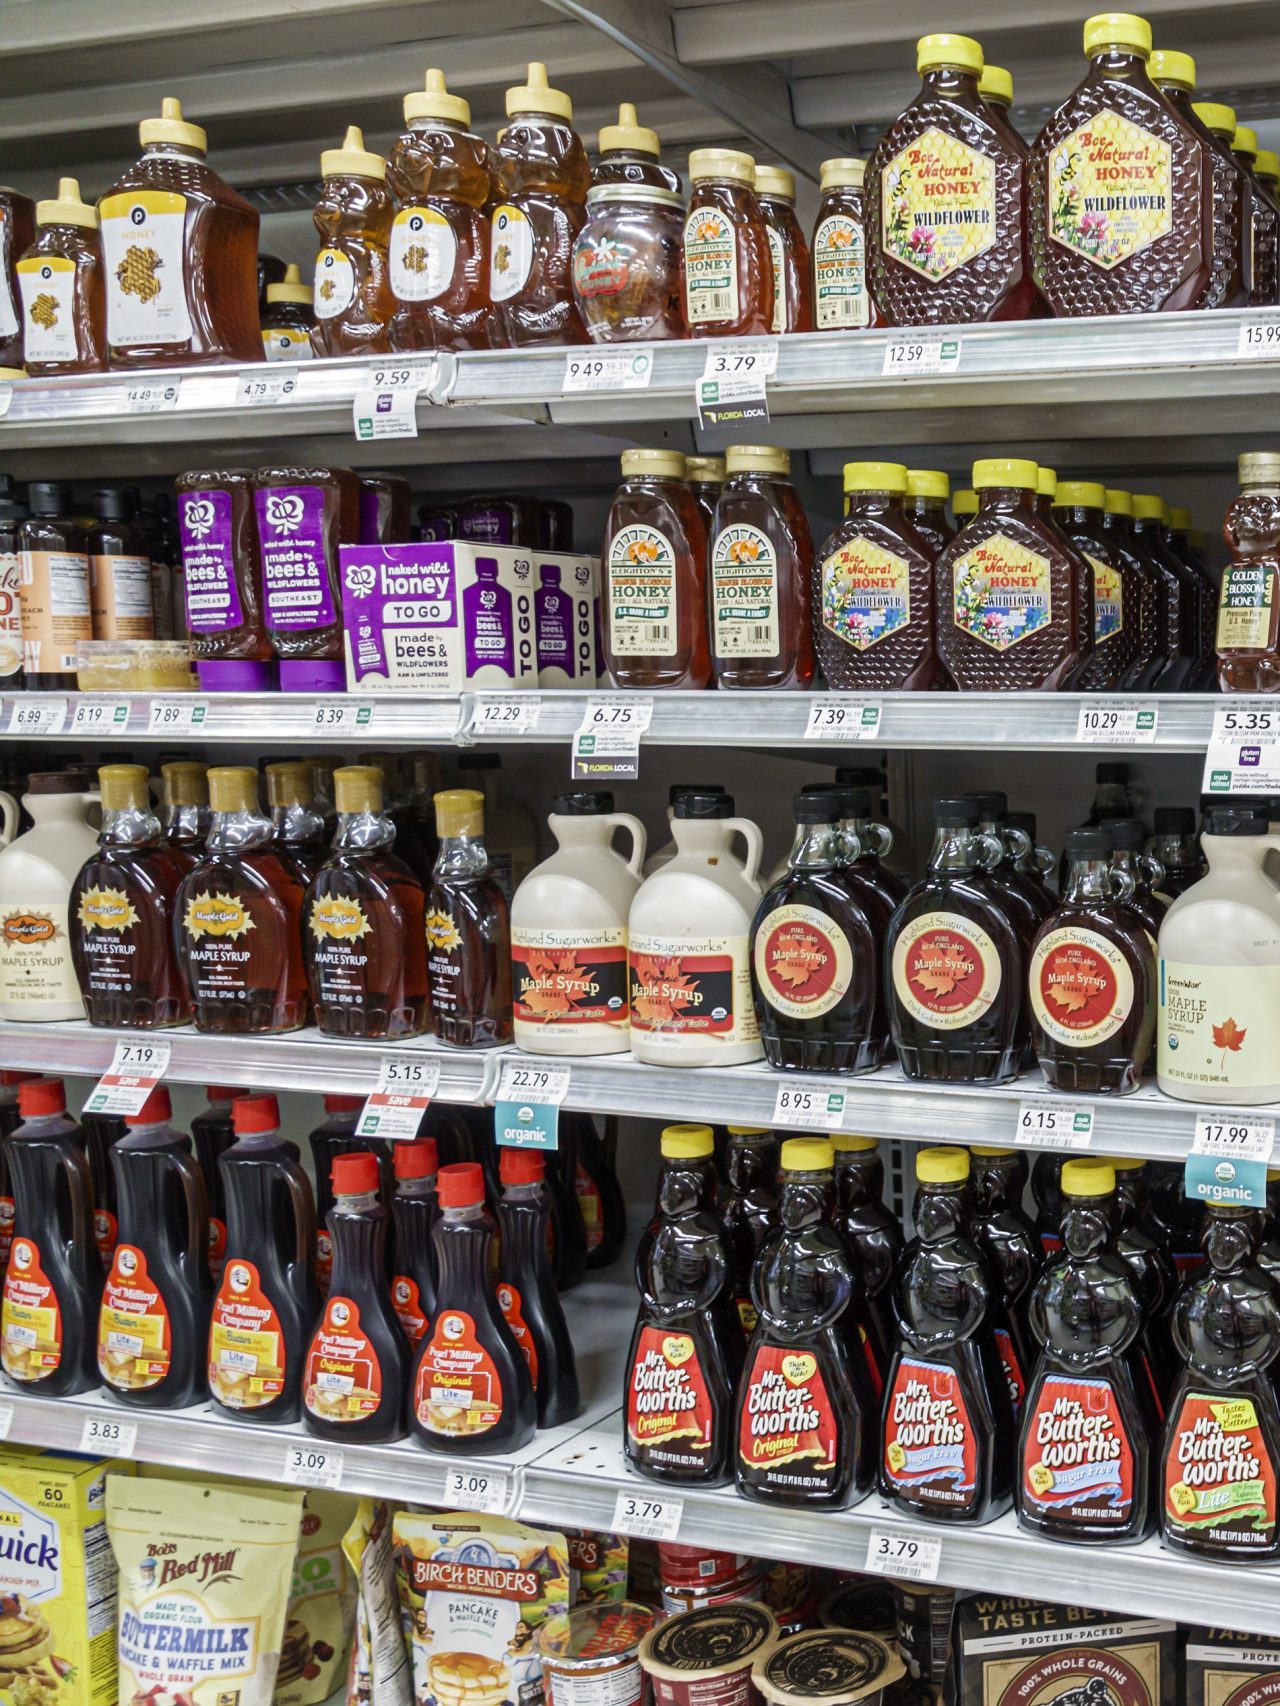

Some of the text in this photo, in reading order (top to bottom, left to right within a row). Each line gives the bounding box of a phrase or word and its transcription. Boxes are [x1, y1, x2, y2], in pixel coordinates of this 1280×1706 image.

[1089, 147, 1149, 162] Natural
[1096, 166, 1157, 180] HONEY
[1084, 196, 1166, 212] WILDFLOWER
[715, 356, 755, 371] 3.79
[375, 371, 410, 385] 9.59
[717, 408, 765, 420] FLORIDA LOCAL
[388, 562, 450, 575] naked wild
[381, 567, 449, 599] honey
[612, 586, 672, 598] HONEY
[394, 605, 440, 618] TO GO
[401, 633, 434, 643] made
[518, 595, 532, 676] TO GO
[395, 637, 447, 657] bees &
[397, 660, 448, 668] WILDFLOWERS
[18, 710, 41, 723] 6.99
[485, 707, 520, 721] 12.29
[594, 708, 632, 722] 6.75
[812, 709, 845, 725] 7.39
[1084, 712, 1117, 729] 10.29
[1224, 714, 1271, 730] 5.35
[191, 950, 250, 961] MAPLE SYRUP
[914, 958, 975, 974] Maple Syrup
[122, 1047, 153, 1062] 7.19
[388, 1065, 422, 1080] 5.15
[512, 1071, 549, 1087] 22.79
[387, 1096, 411, 1106] save
[781, 1092, 811, 1110] 8.95
[1023, 1112, 1056, 1130] 6.15
[504, 1127, 547, 1143] organic
[1204, 1126, 1248, 1143] 17.99
[1197, 1182, 1252, 1200] organic
[762, 1371, 785, 1388] Mrs.
[89, 1422, 120, 1439] 3.83
[753, 1434, 799, 1458] Original
[293, 1452, 325, 1469] 3.09
[454, 1475, 488, 1492] 3.09
[626, 1500, 662, 1519] 3.79
[879, 1538, 918, 1558] 3.79
[414, 1562, 539, 1595] BIRCH BENDERS
[121, 1612, 249, 1653] BUTTERMILK
[1020, 1626, 1124, 1646] PROTEIN-PACKED
